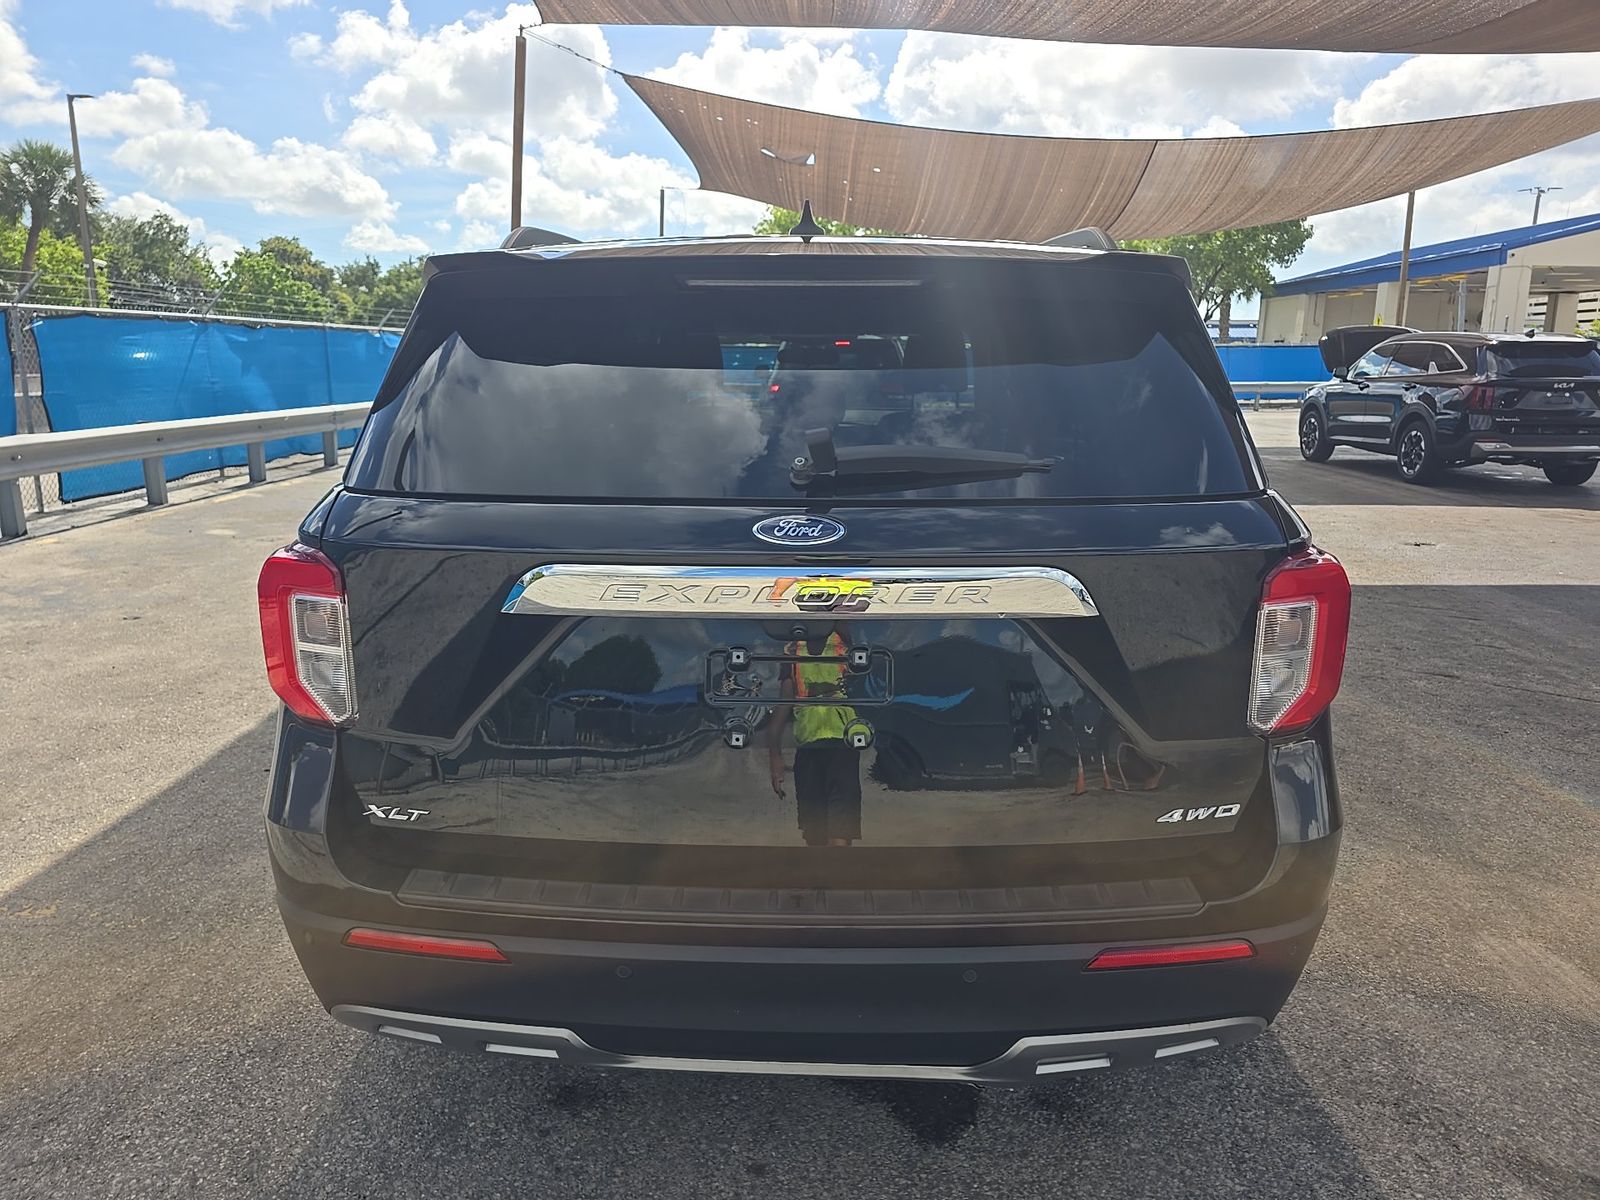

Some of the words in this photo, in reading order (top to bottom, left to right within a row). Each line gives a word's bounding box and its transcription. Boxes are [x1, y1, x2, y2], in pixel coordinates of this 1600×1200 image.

[774, 518, 824, 537] Ford
[599, 583, 993, 605] EXPLORER
[362, 804, 431, 822] XLT
[1156, 803, 1241, 823] 4WD
